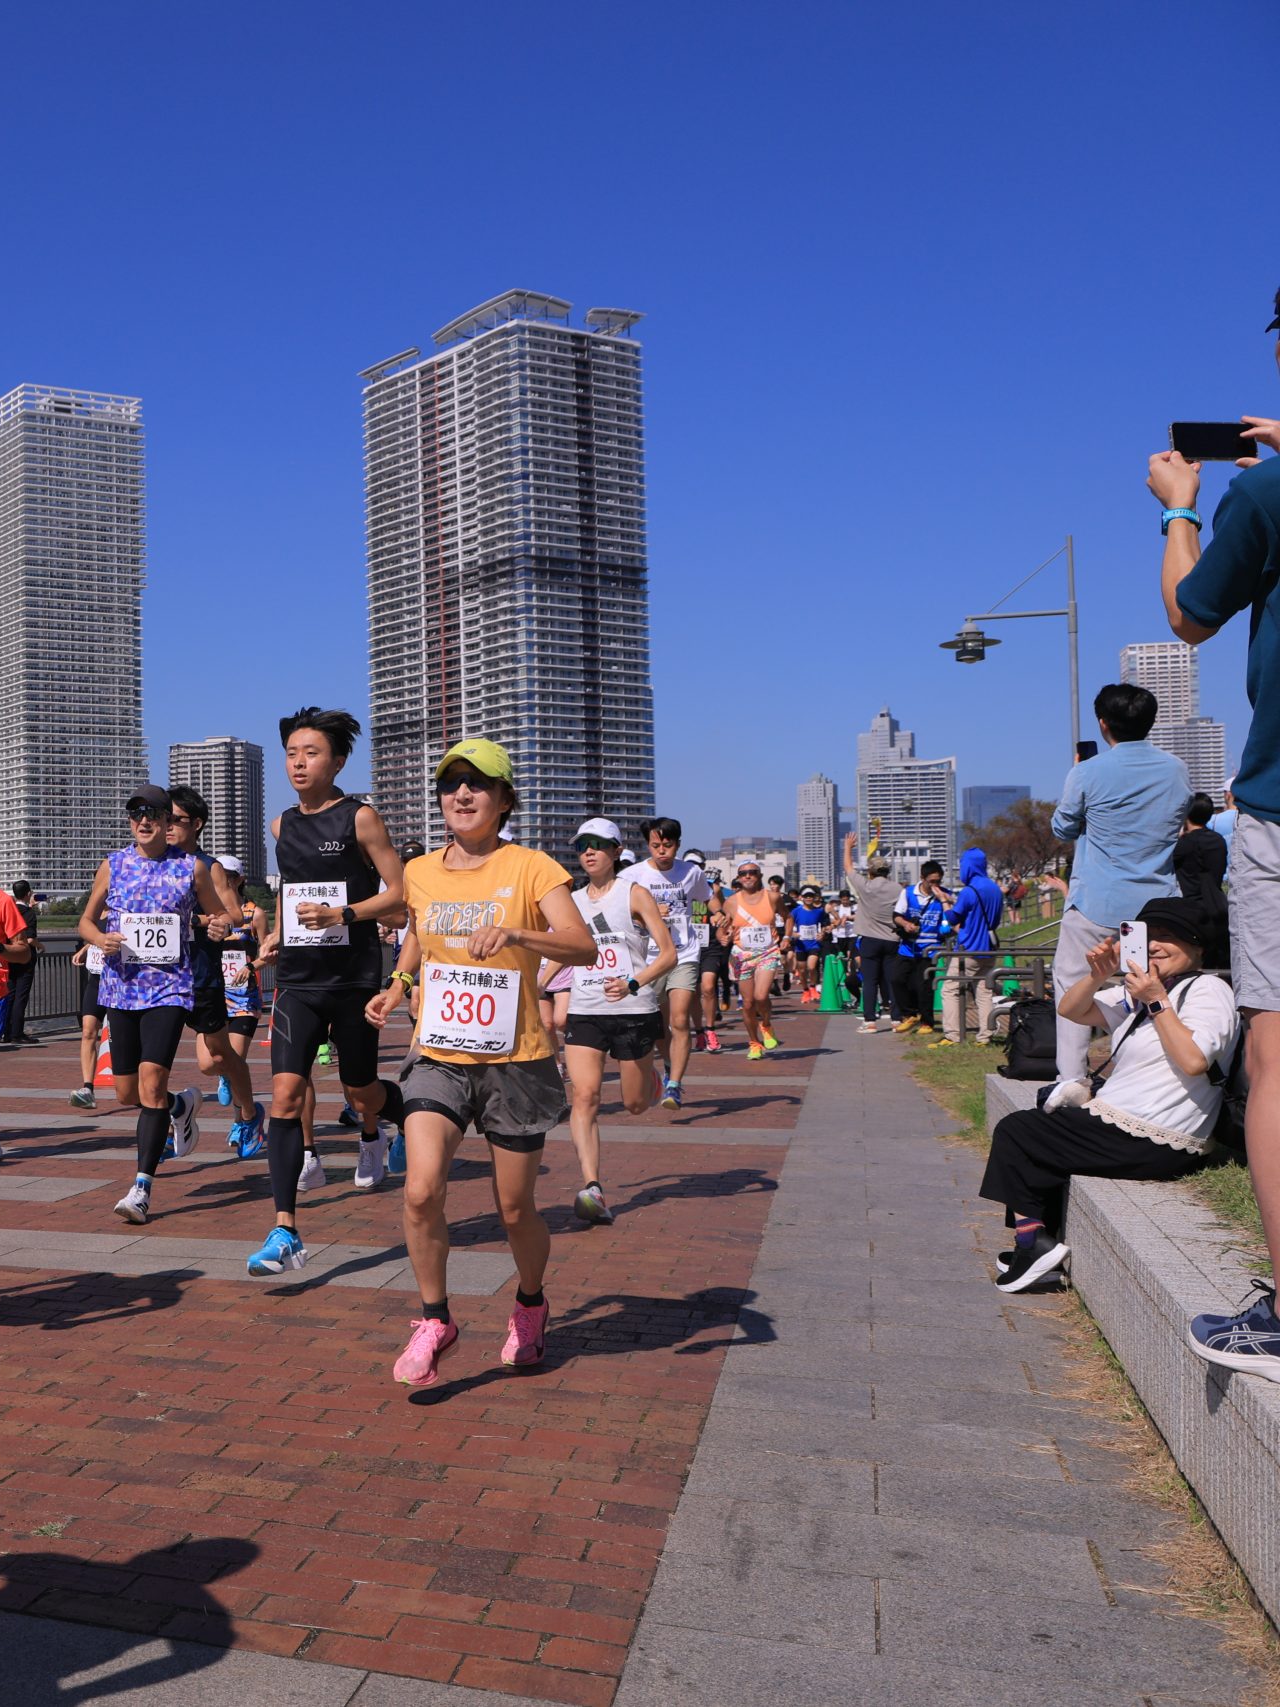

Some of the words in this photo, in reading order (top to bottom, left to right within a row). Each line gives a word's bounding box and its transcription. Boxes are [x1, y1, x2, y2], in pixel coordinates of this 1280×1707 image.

[298, 886, 340, 898] 大和輸送
[137, 917, 174, 926] 大和輸送
[133, 928, 168, 949] 126
[287, 935, 344, 944] スポーツニッポン
[444, 937, 469, 949] NAGOY
[747, 933, 766, 944] 145
[222, 962, 238, 978] 25
[448, 969, 509, 990] 大和輸送
[440, 990, 496, 1027] 330
[425, 1033, 507, 1052] スポーツニッポン
